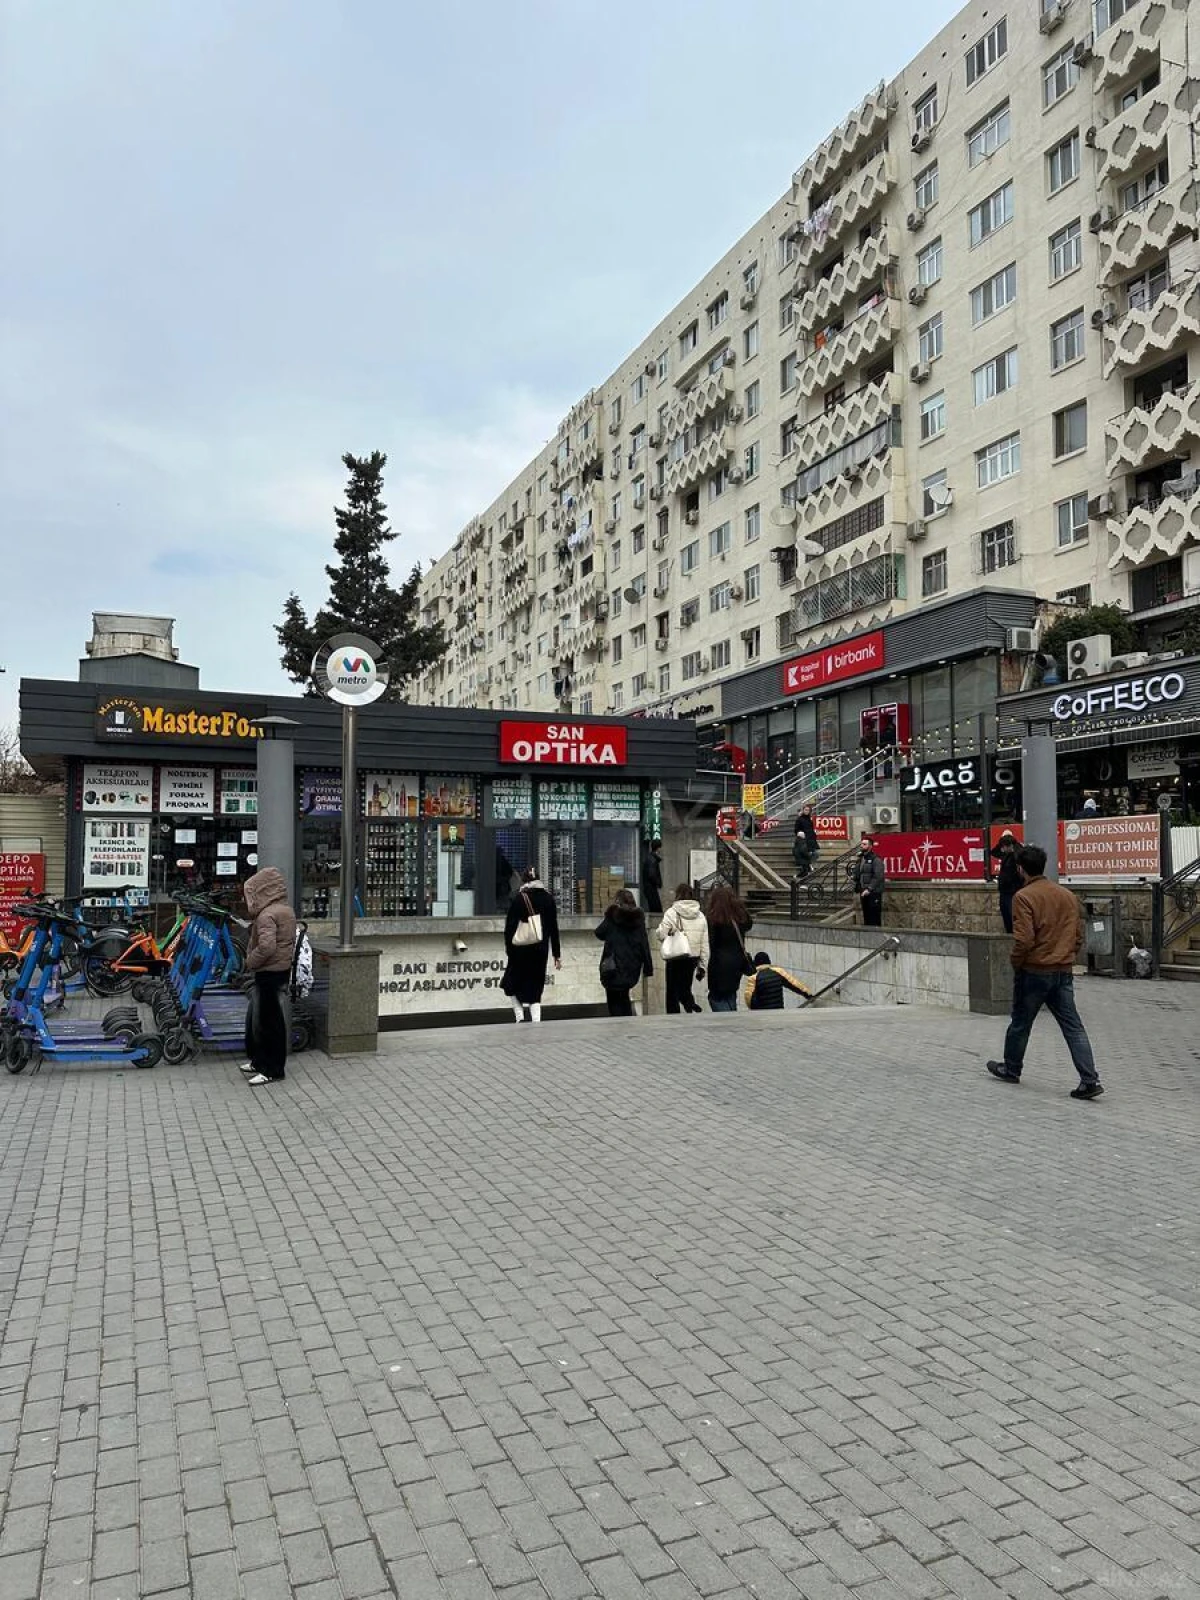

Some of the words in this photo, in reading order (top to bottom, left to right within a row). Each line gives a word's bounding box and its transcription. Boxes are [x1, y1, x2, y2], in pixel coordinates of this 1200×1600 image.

[834, 643, 876, 668] birbank
[800, 660, 820, 673] Kapital
[337, 675, 368, 685] metro
[800, 672, 815, 683] Bank
[547, 725, 584, 740] SAN
[97, 768, 139, 778] TELEFON
[815, 816, 842, 829] FOTO
[1080, 820, 1158, 836] PROFESSİONAL
[1066, 842, 1113, 854] TELEFON
[1115, 837, 1158, 852] TƏMİRİ
[1067, 860, 1104, 869] TELEFON
[393, 963, 427, 975] BAKI
